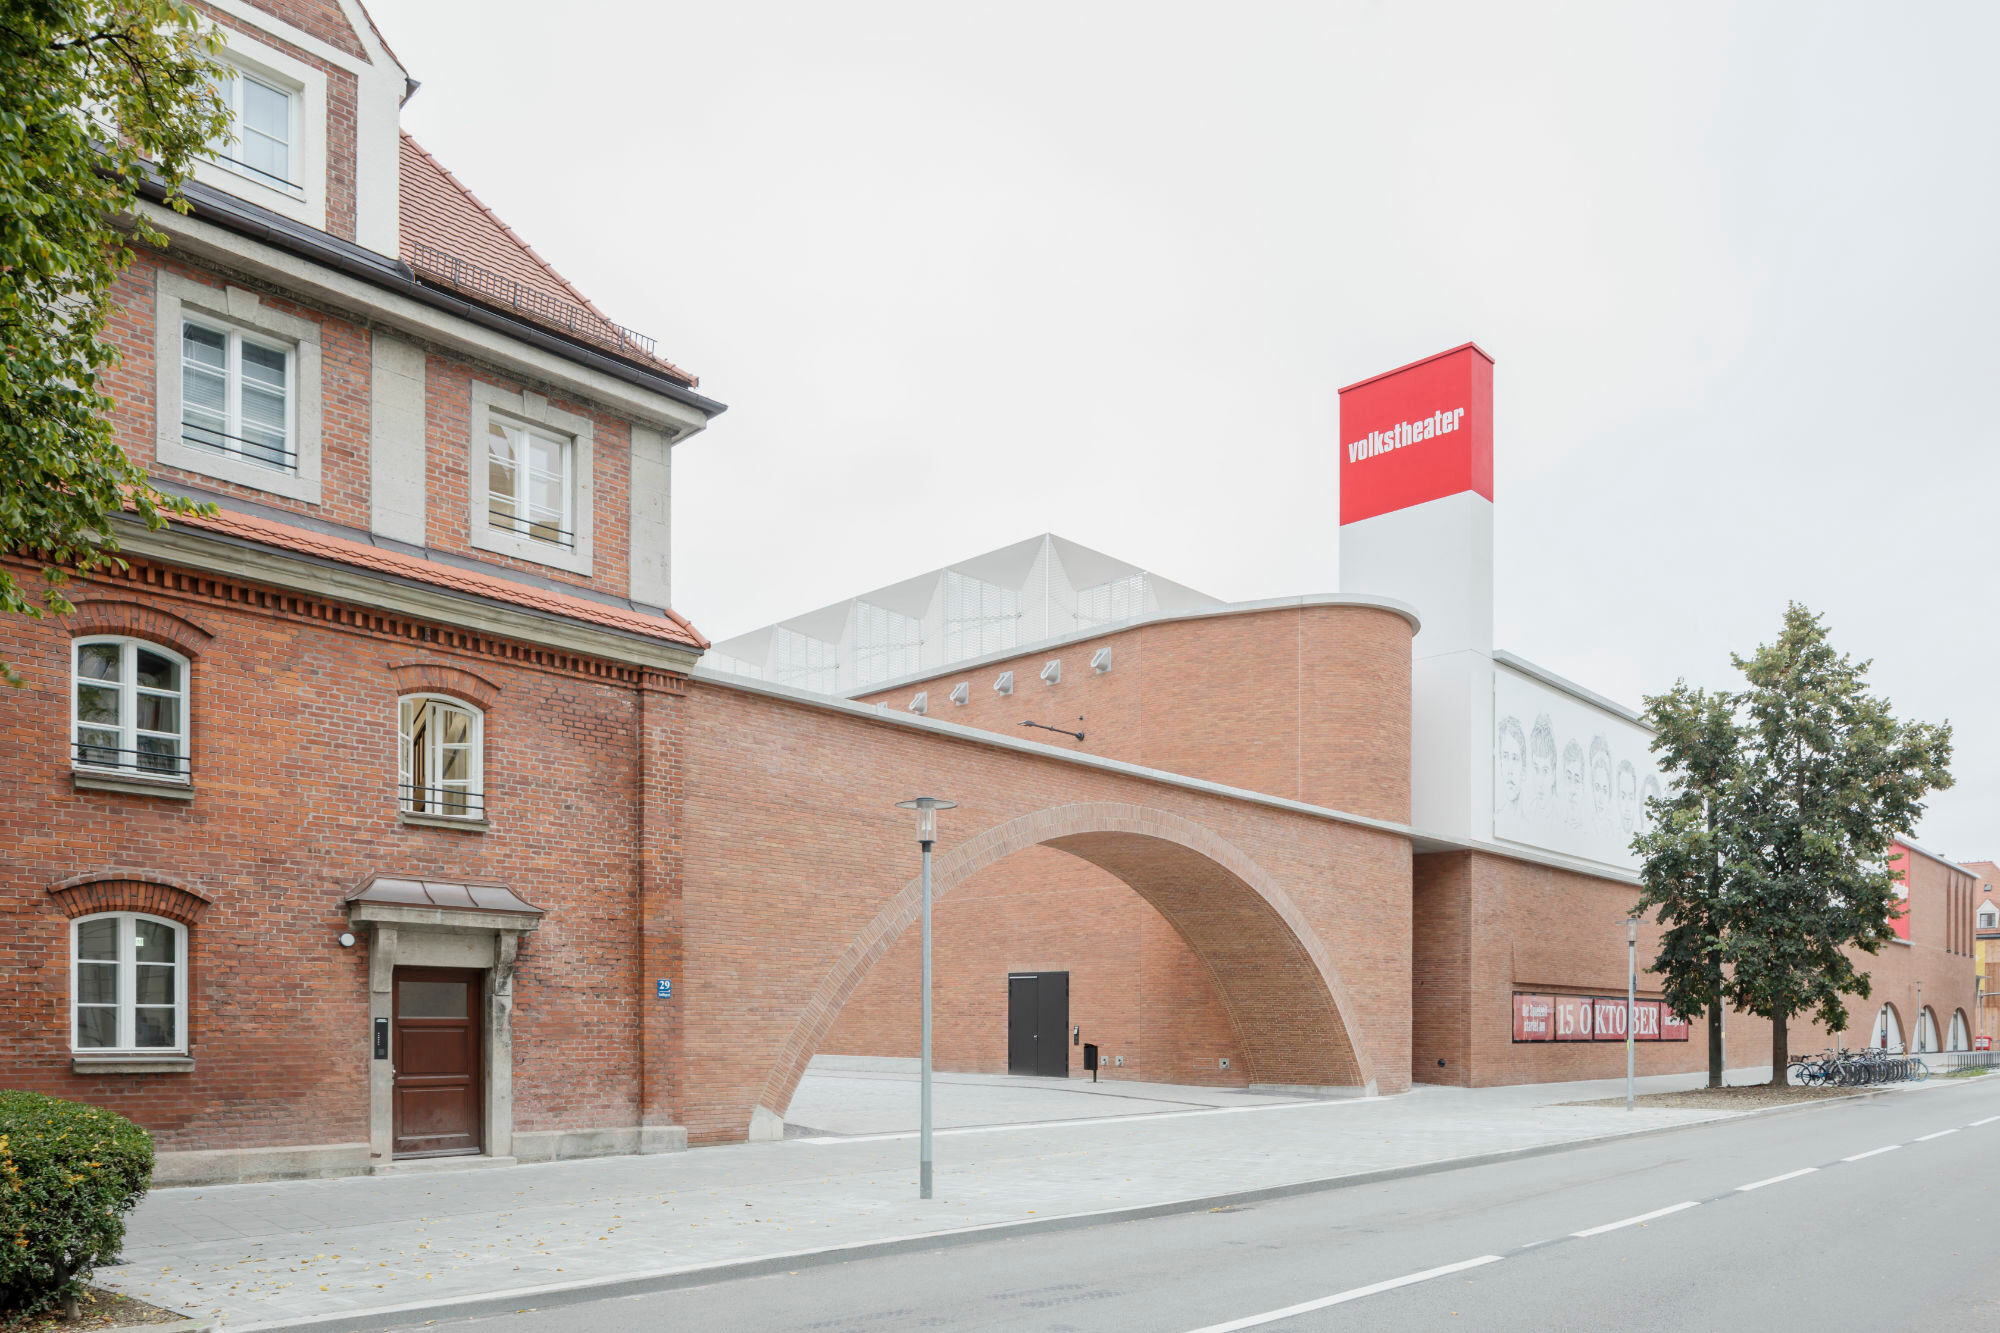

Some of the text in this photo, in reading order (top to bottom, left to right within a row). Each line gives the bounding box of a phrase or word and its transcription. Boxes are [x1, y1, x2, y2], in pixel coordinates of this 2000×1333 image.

[1348, 407, 1464, 463] volkstheater
[659, 981, 670, 989] 29
[1558, 1004, 1574, 1034] 15
